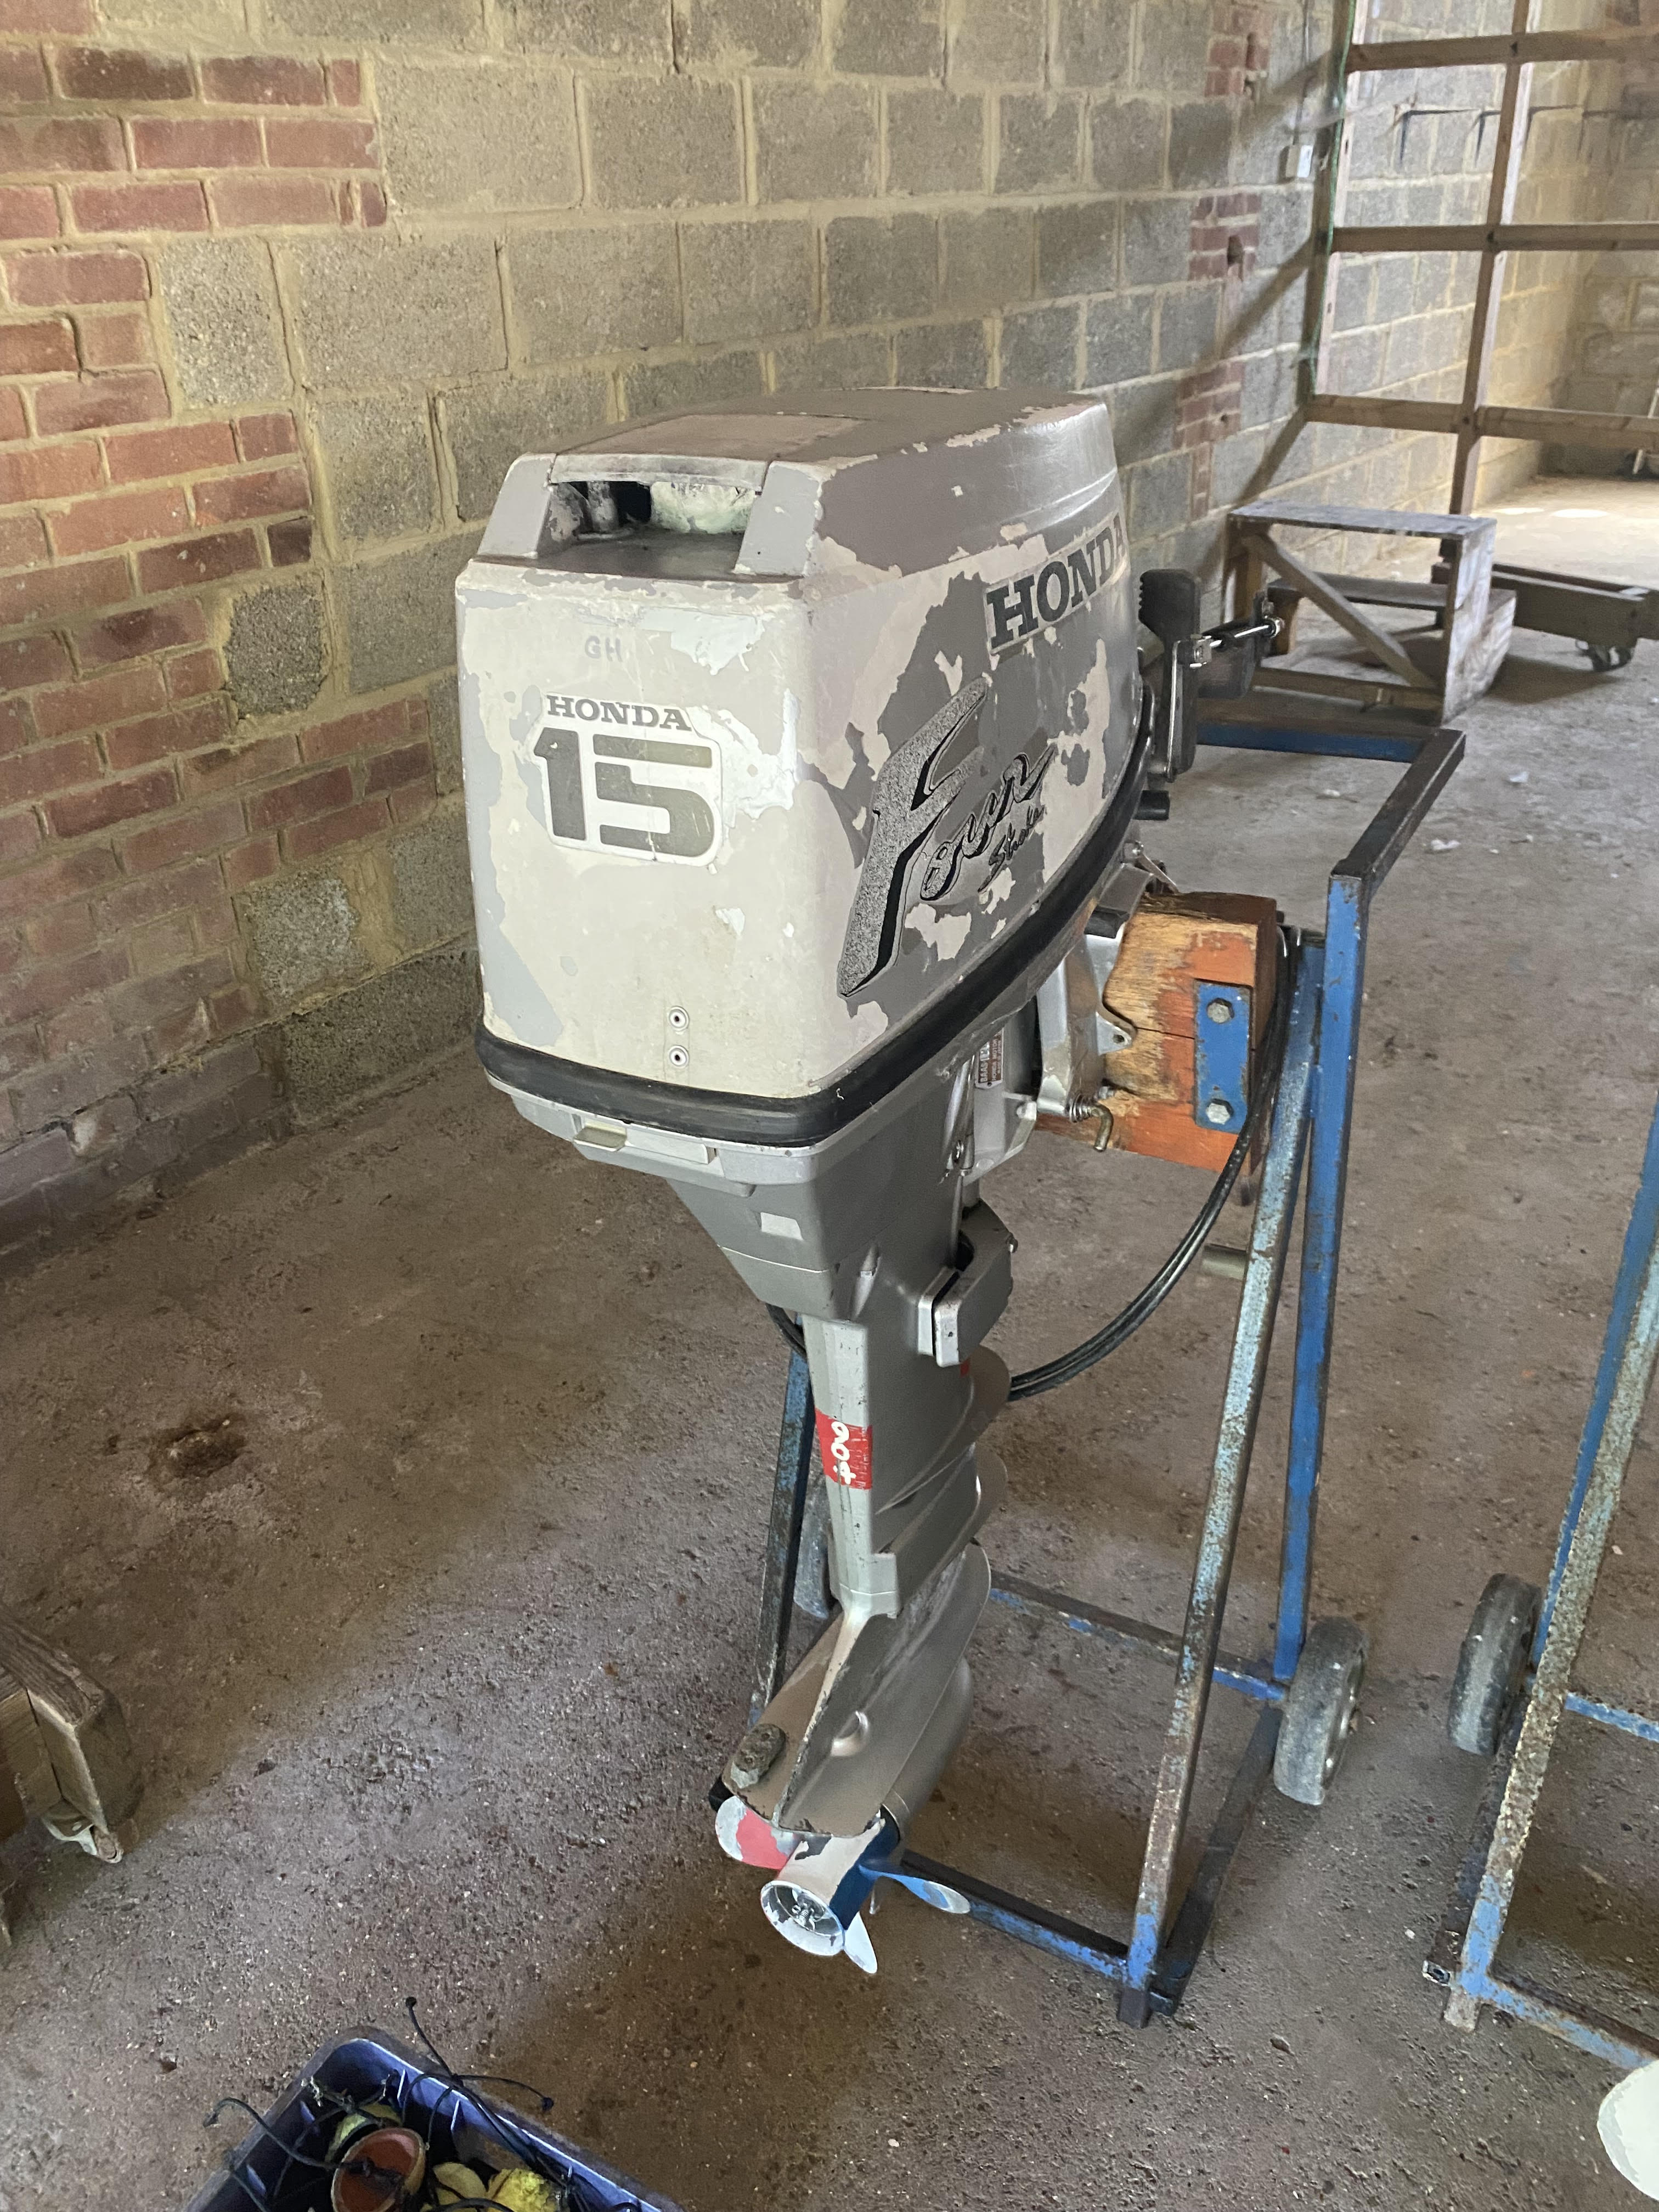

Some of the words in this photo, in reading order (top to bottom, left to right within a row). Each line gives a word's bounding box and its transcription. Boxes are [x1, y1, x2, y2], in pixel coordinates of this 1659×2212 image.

[987, 512, 1126, 650] HONDA
[584, 635, 623, 662] GH
[547, 695, 692, 731] HONDA
[533, 726, 715, 857] 15
